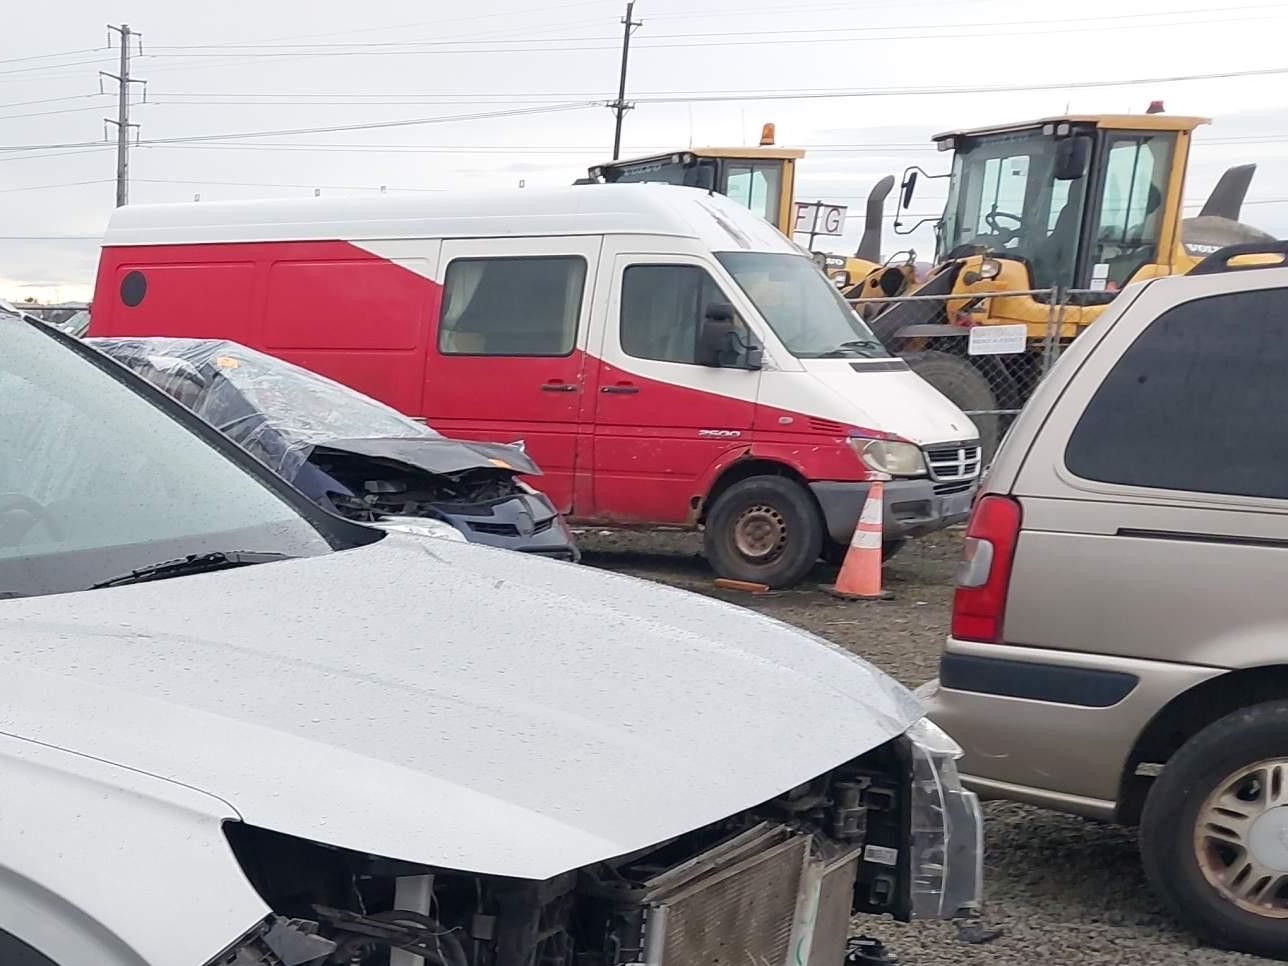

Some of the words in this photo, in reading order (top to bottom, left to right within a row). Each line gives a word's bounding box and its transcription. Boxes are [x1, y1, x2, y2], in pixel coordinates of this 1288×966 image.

[795, 204, 809, 230] F
[824, 207, 841, 233] G
[698, 429, 741, 437] 2500
